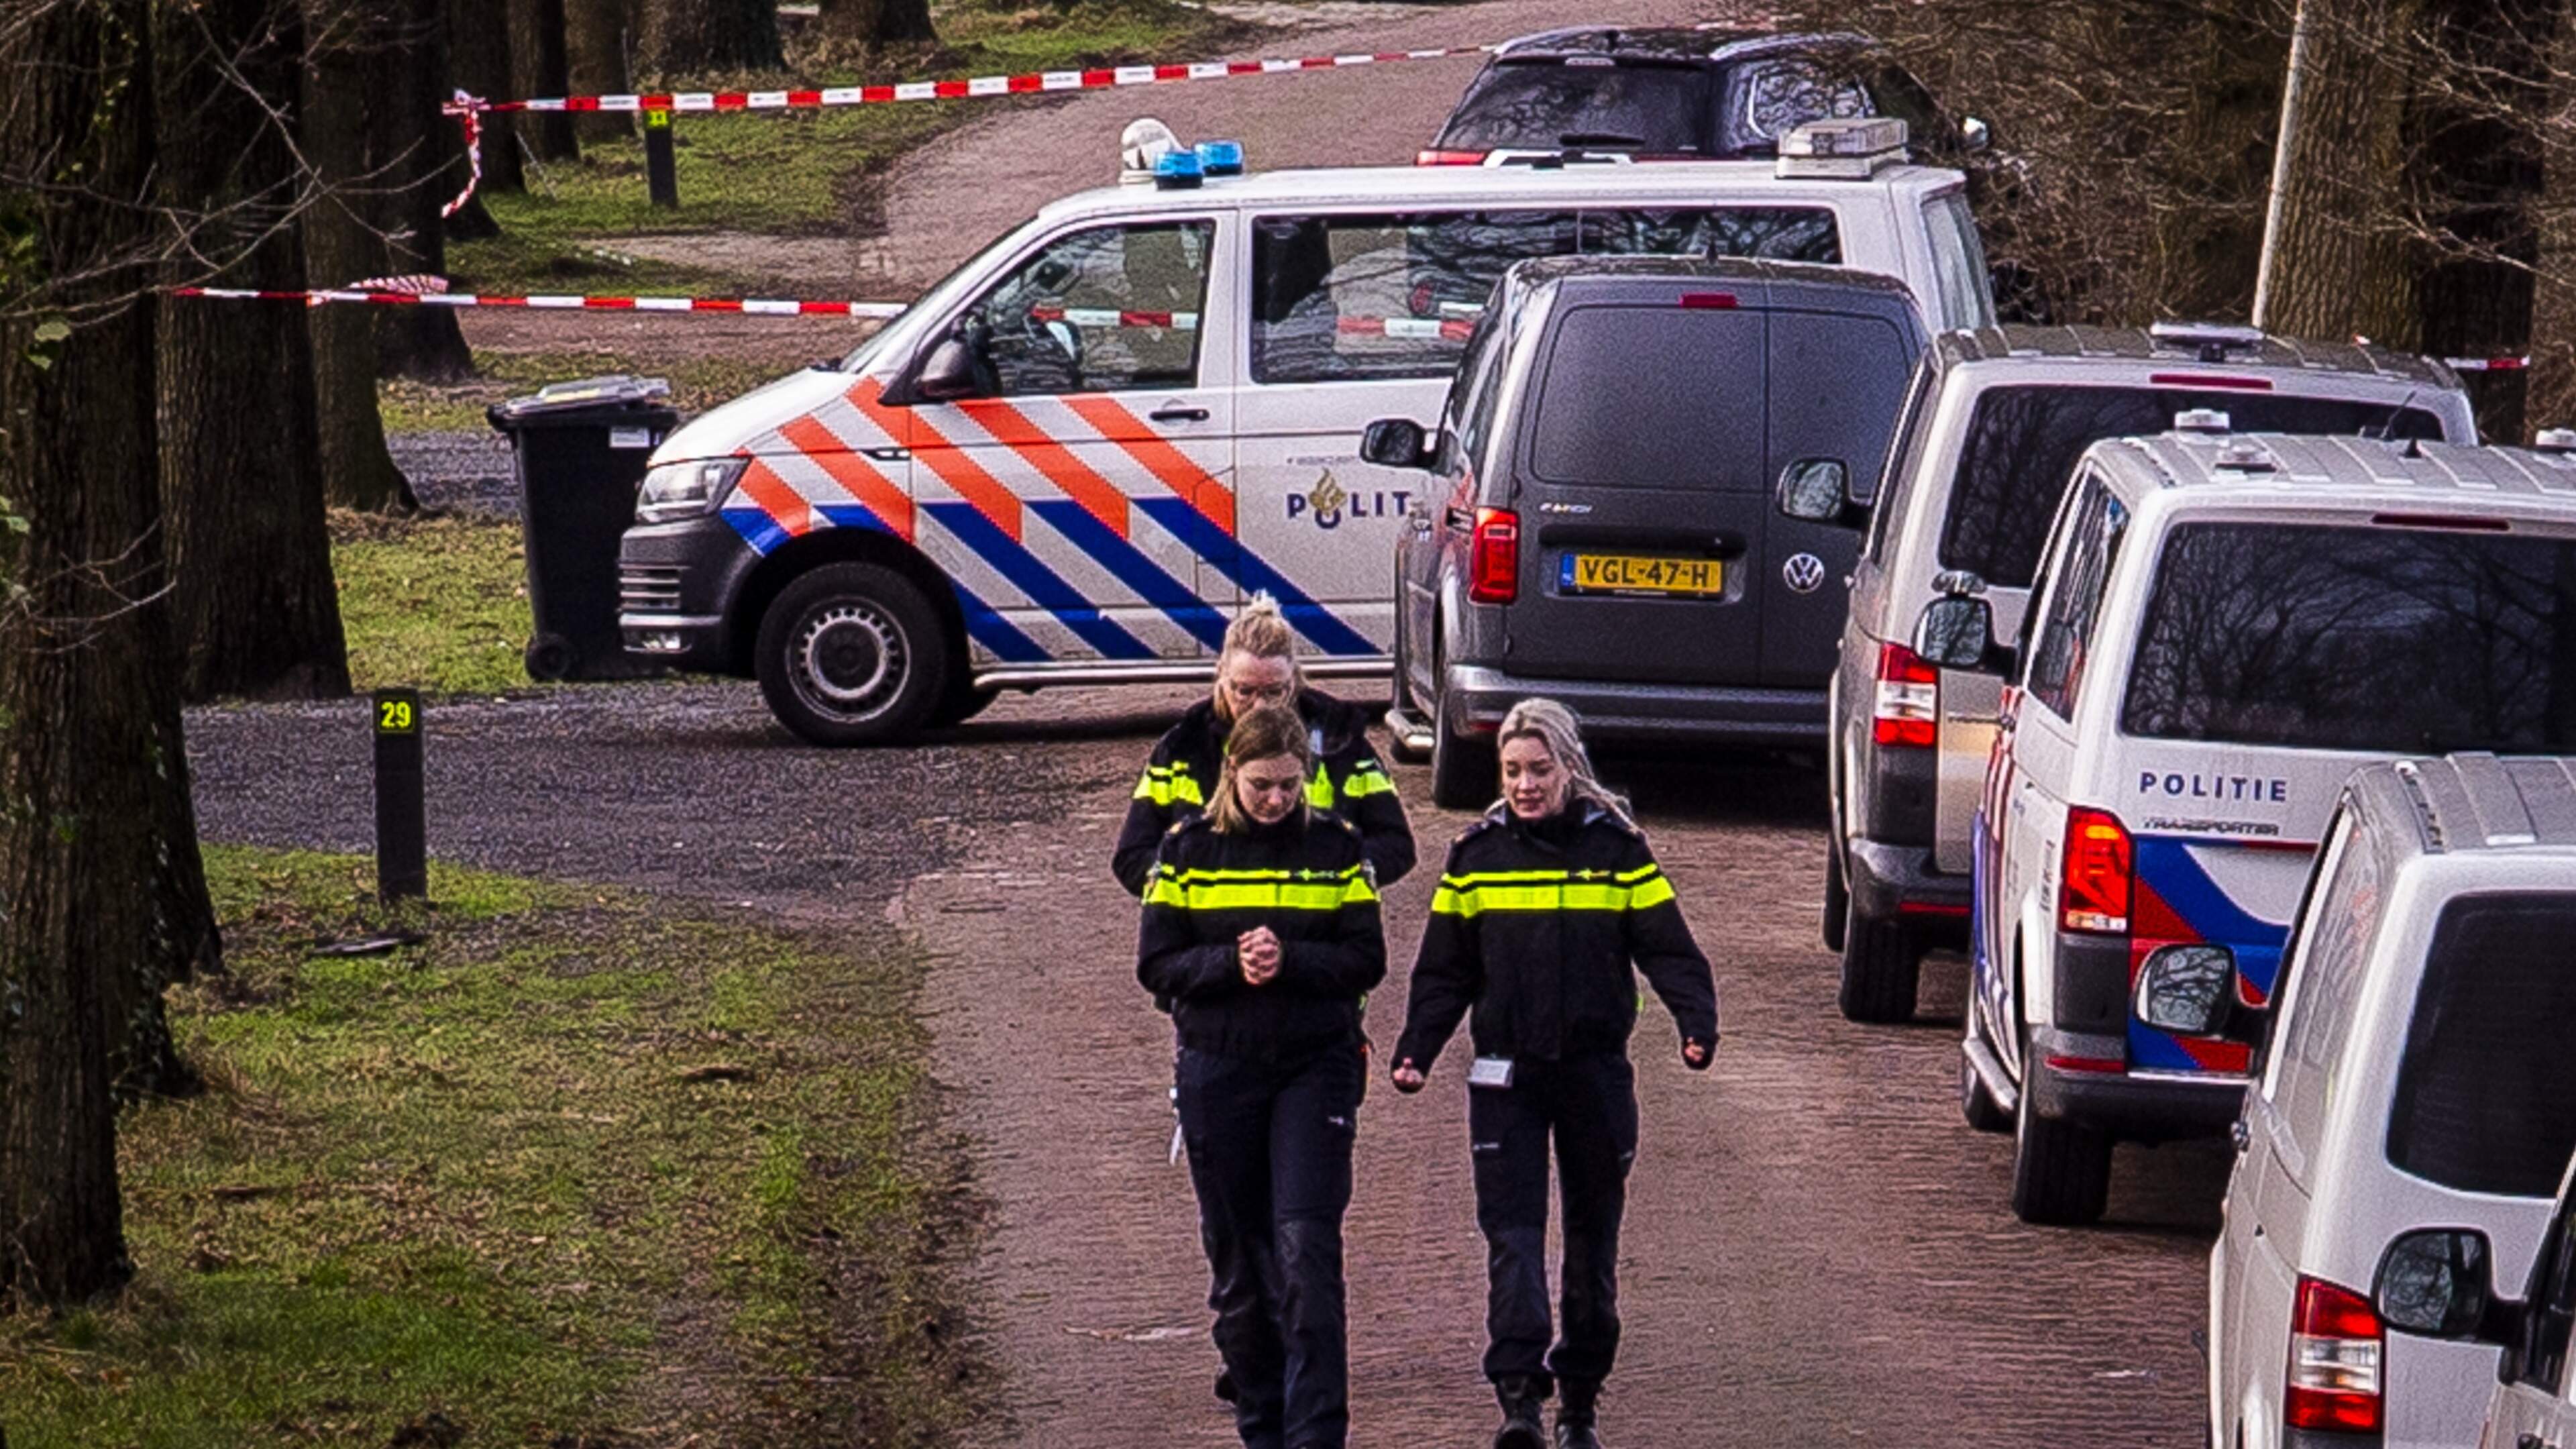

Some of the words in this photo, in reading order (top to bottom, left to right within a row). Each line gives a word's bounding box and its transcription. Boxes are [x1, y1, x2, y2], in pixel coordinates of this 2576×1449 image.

[1287, 491, 1411, 529] POLIT
[1582, 558, 1710, 588] VGL-47-H
[381, 701, 411, 728] 29
[2139, 771, 2288, 802] POLITIE
